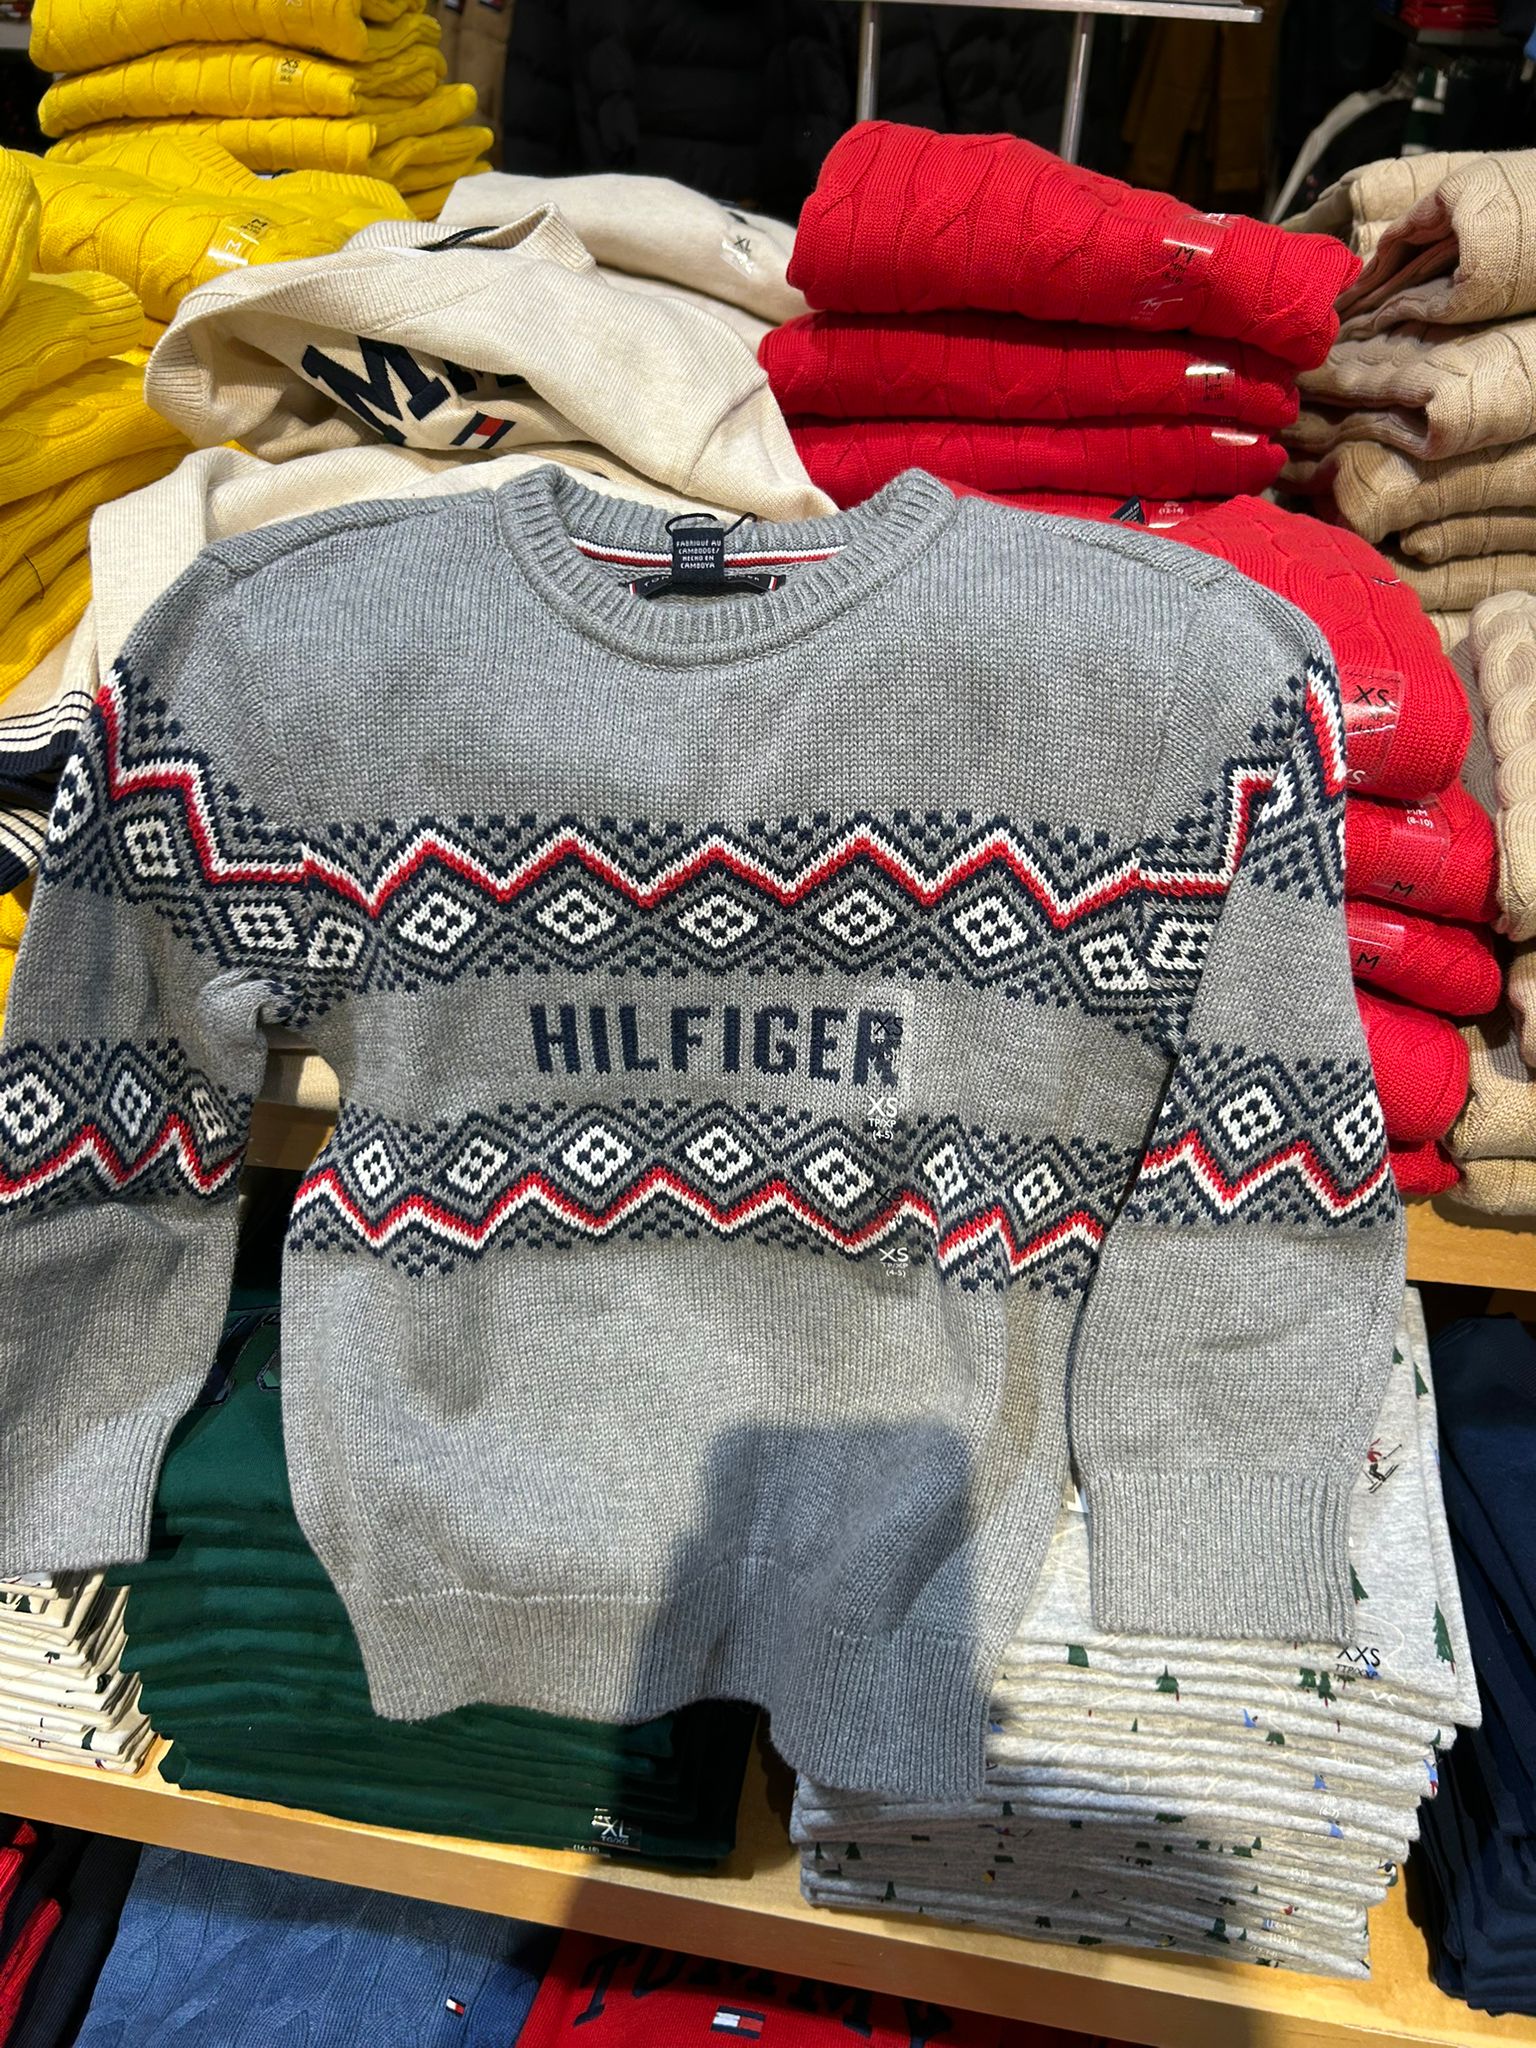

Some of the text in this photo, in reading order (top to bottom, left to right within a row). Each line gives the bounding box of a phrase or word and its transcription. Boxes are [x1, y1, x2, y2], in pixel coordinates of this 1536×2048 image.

[1353, 684, 1390, 708] XS
[1388, 880, 1415, 898] M
[1356, 952, 1380, 970] M
[529, 1003, 899, 1087] HILFIGER
[867, 1095, 898, 1118] XS
[868, 1117, 897, 1128] TP/XP
[872, 1130, 894, 1141] (4-5)
[878, 1247, 909, 1263] XS
[885, 1269, 906, 1278] (4-5)
[1337, 1646, 1381, 1667] XXS
[601, 1817, 630, 1839] XL
